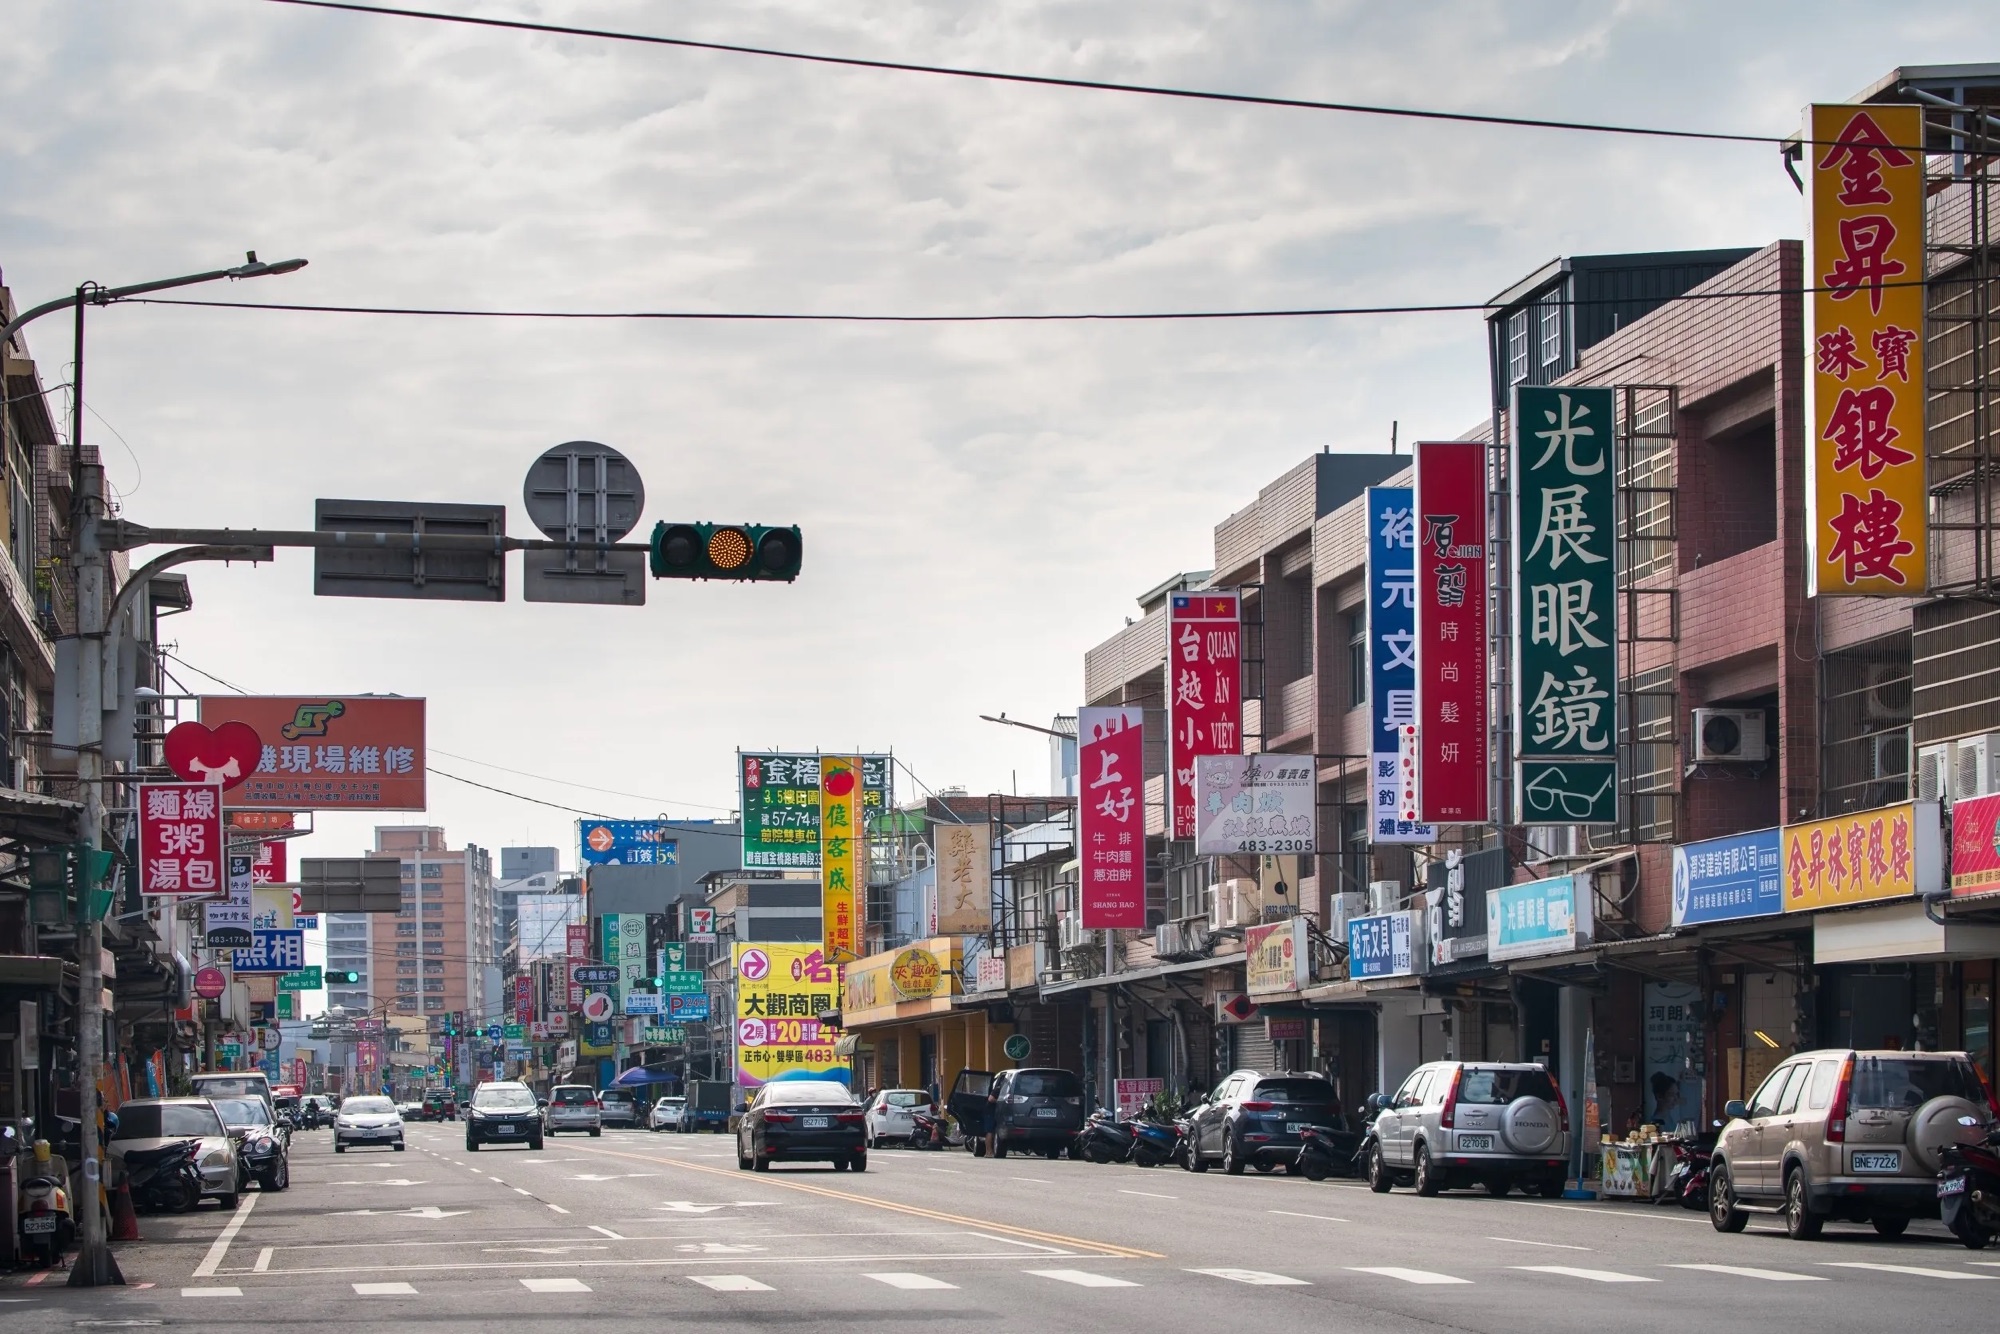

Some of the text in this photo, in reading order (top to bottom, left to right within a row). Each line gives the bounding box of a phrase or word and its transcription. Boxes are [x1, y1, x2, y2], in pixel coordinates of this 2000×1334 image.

[1817, 111, 1915, 316] 金昇
[1816, 325, 1919, 382] 珠寶
[1822, 386, 1916, 586] 銀樓
[1525, 394, 1610, 752] 光展眼鏡
[1207, 631, 1236, 665] QUAN
[1214, 669, 1230, 703] ĂN
[1440, 621, 1460, 764] 時尚髮妍
[1090, 750, 1135, 823] 上好
[147, 788, 216, 821] 麵線
[160, 823, 205, 856] 粥
[1378, 818, 1431, 835] 繡學號
[826, 804, 851, 891] 億客成
[1093, 850, 1132, 864] 牛肉麵
[1238, 840, 1313, 852] 483-2305
[1787, 812, 1911, 900] 金昇珠寶銀樓
[148, 857, 216, 890] 湯包
[855, 835, 863, 905] SUPERMARKET
[1093, 901, 1135, 909] SHANG HAO
[209, 935, 250, 944] 483-1784
[836, 902, 849, 951] 生鮮超市
[1352, 919, 1390, 960] 裕元文具
[236, 934, 303, 967] 照相
[576, 970, 618, 980] 手機配件
[670, 997, 684, 1016] P
[1650, 1005, 1697, 1022] 珂朗
[777, 1020, 801, 1043] 20
[1513, 1120, 1550, 1129] HONDA
